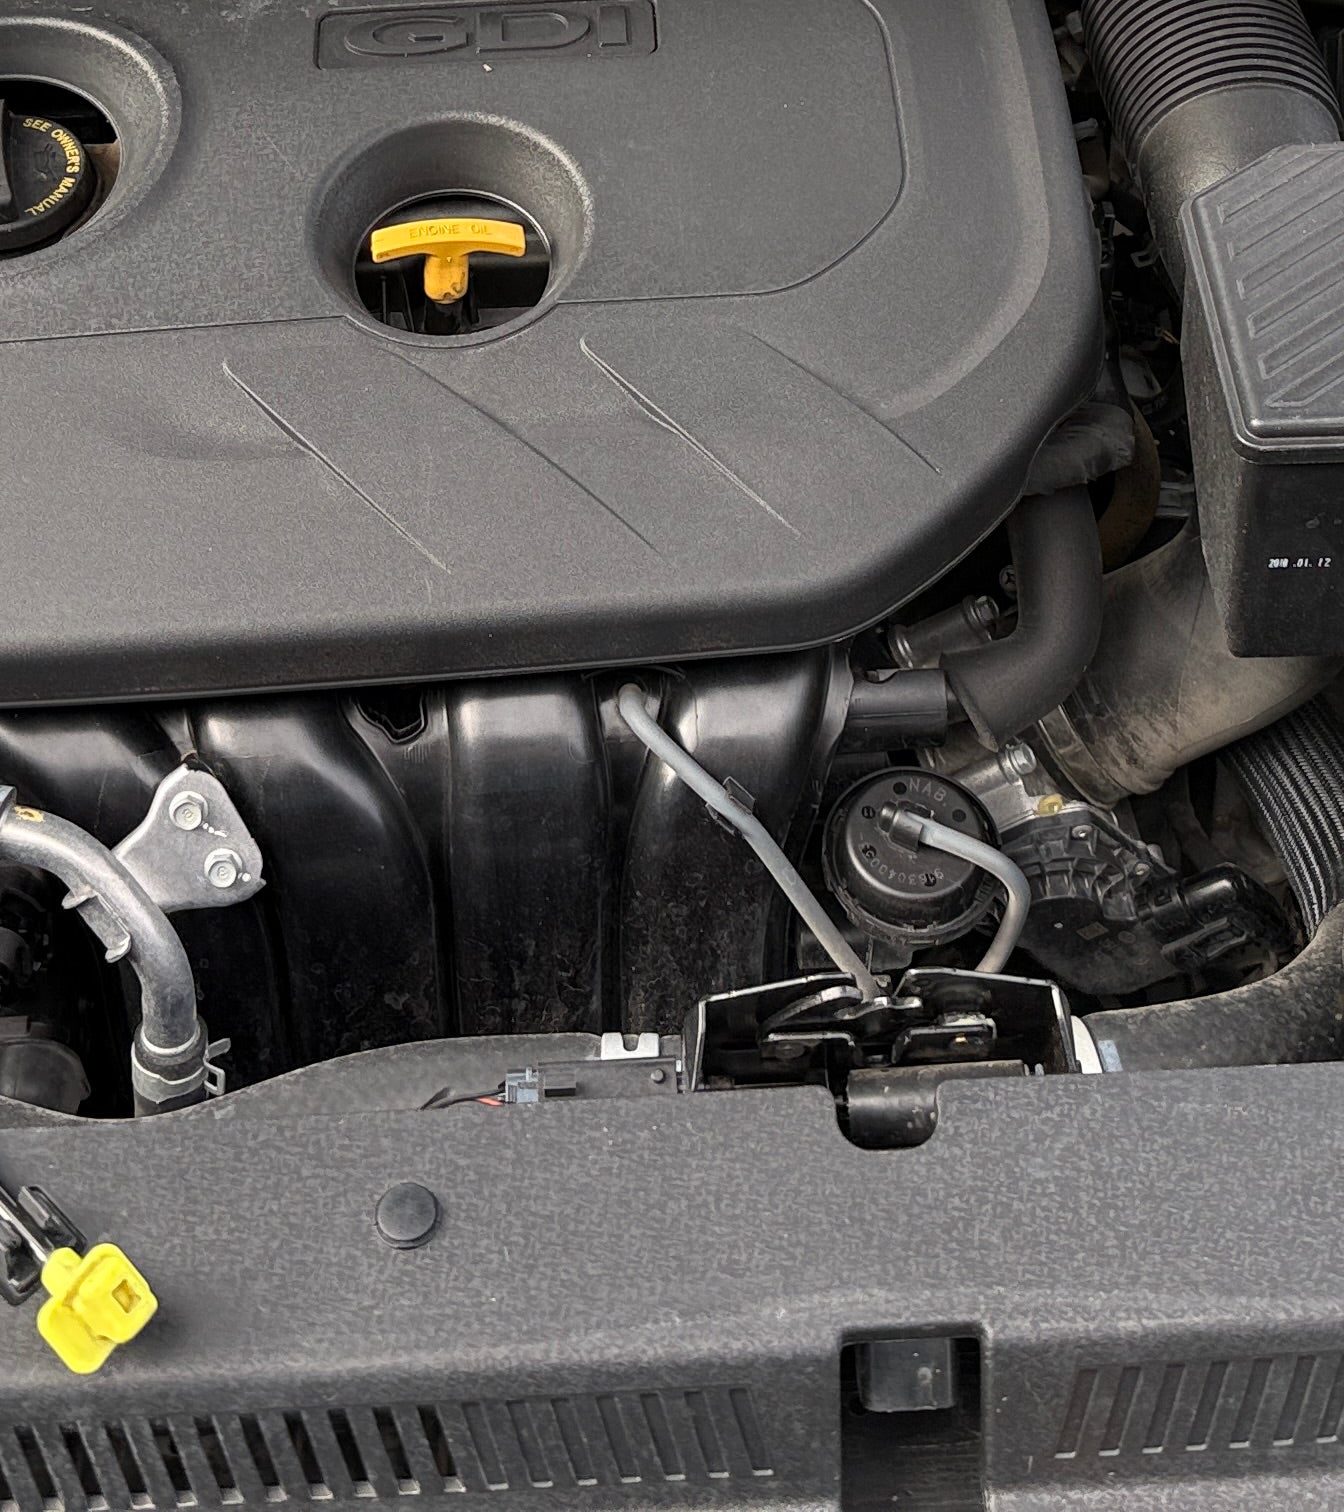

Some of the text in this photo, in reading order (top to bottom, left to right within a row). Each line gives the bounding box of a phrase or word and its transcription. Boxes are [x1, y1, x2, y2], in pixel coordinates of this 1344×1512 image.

[344, 6, 632, 57] GDI
[23, 118, 81, 216] SEE OWNER'S MANUAL
[409, 224, 492, 239] ENGINE OIL
